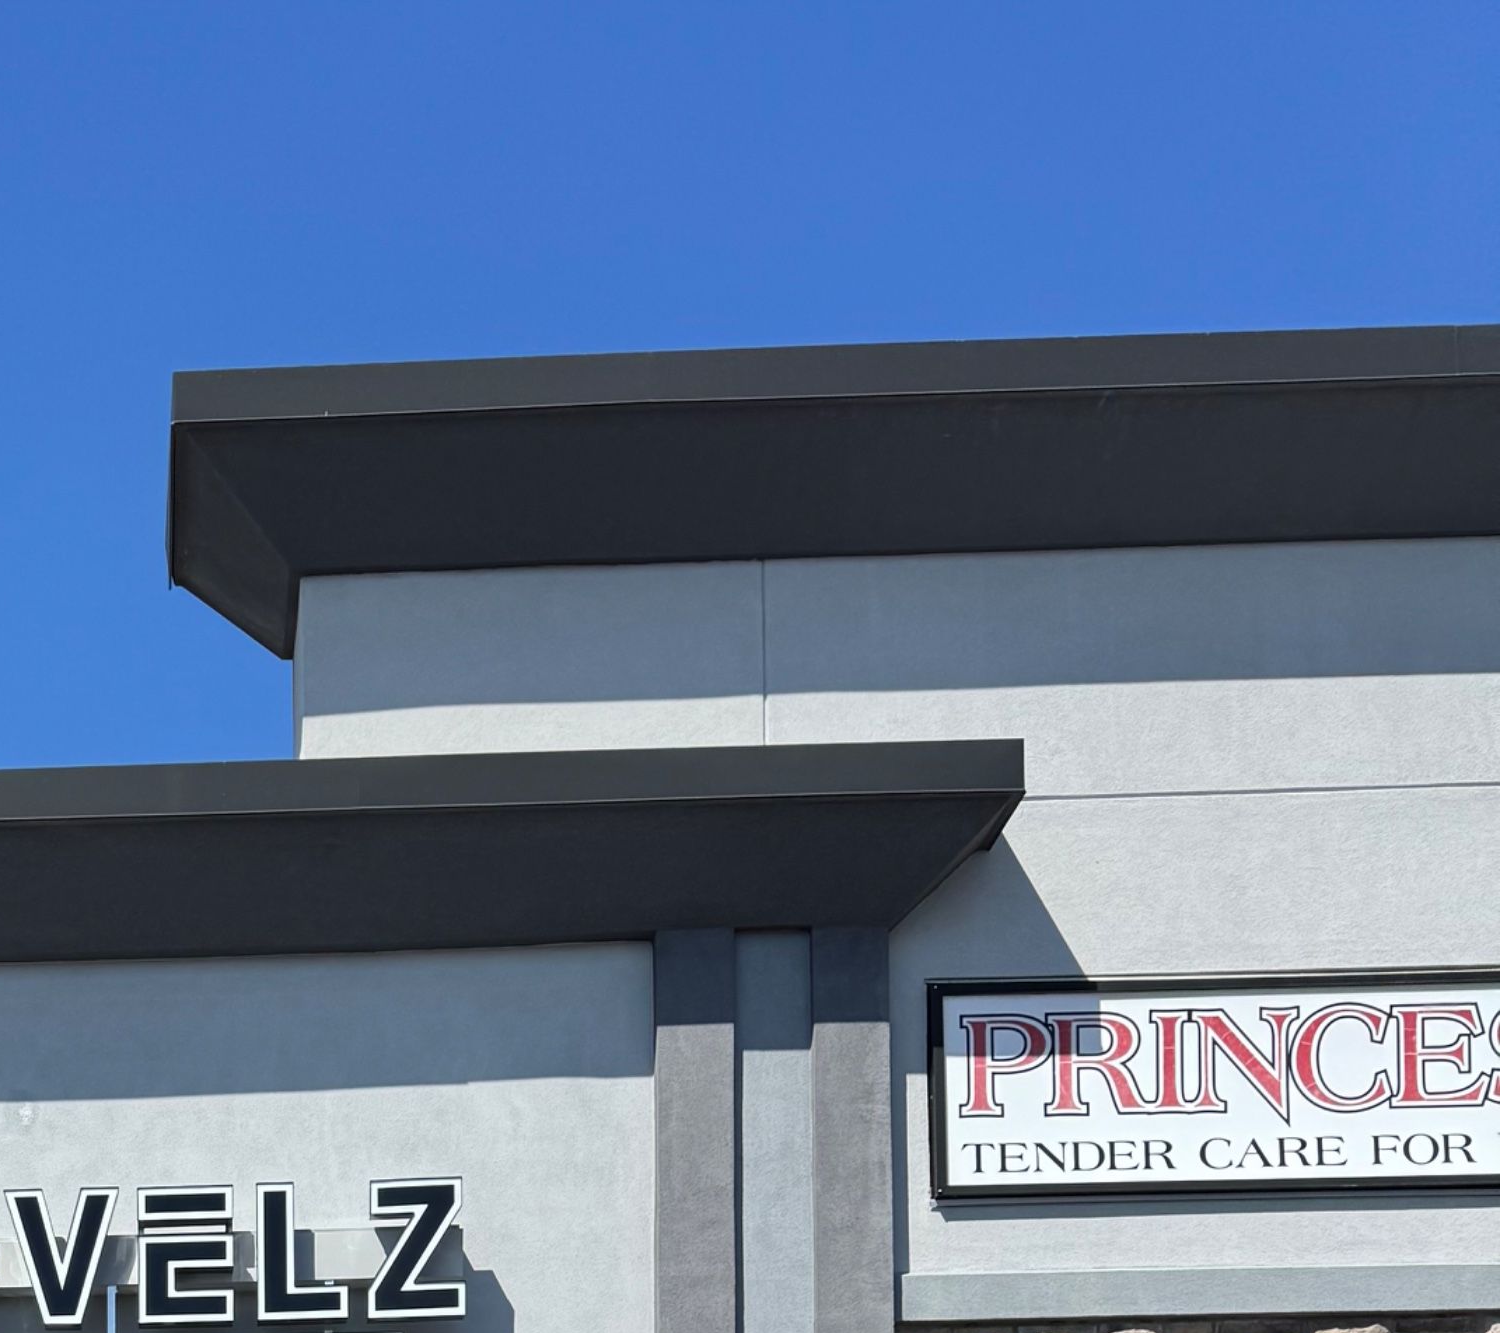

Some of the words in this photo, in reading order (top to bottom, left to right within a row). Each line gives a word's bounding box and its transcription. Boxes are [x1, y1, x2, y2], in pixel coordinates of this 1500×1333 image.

[961, 1139, 1176, 1174] TENDER
[1200, 1136, 1348, 1171] CARE
[1372, 1133, 1477, 1167] FOR
